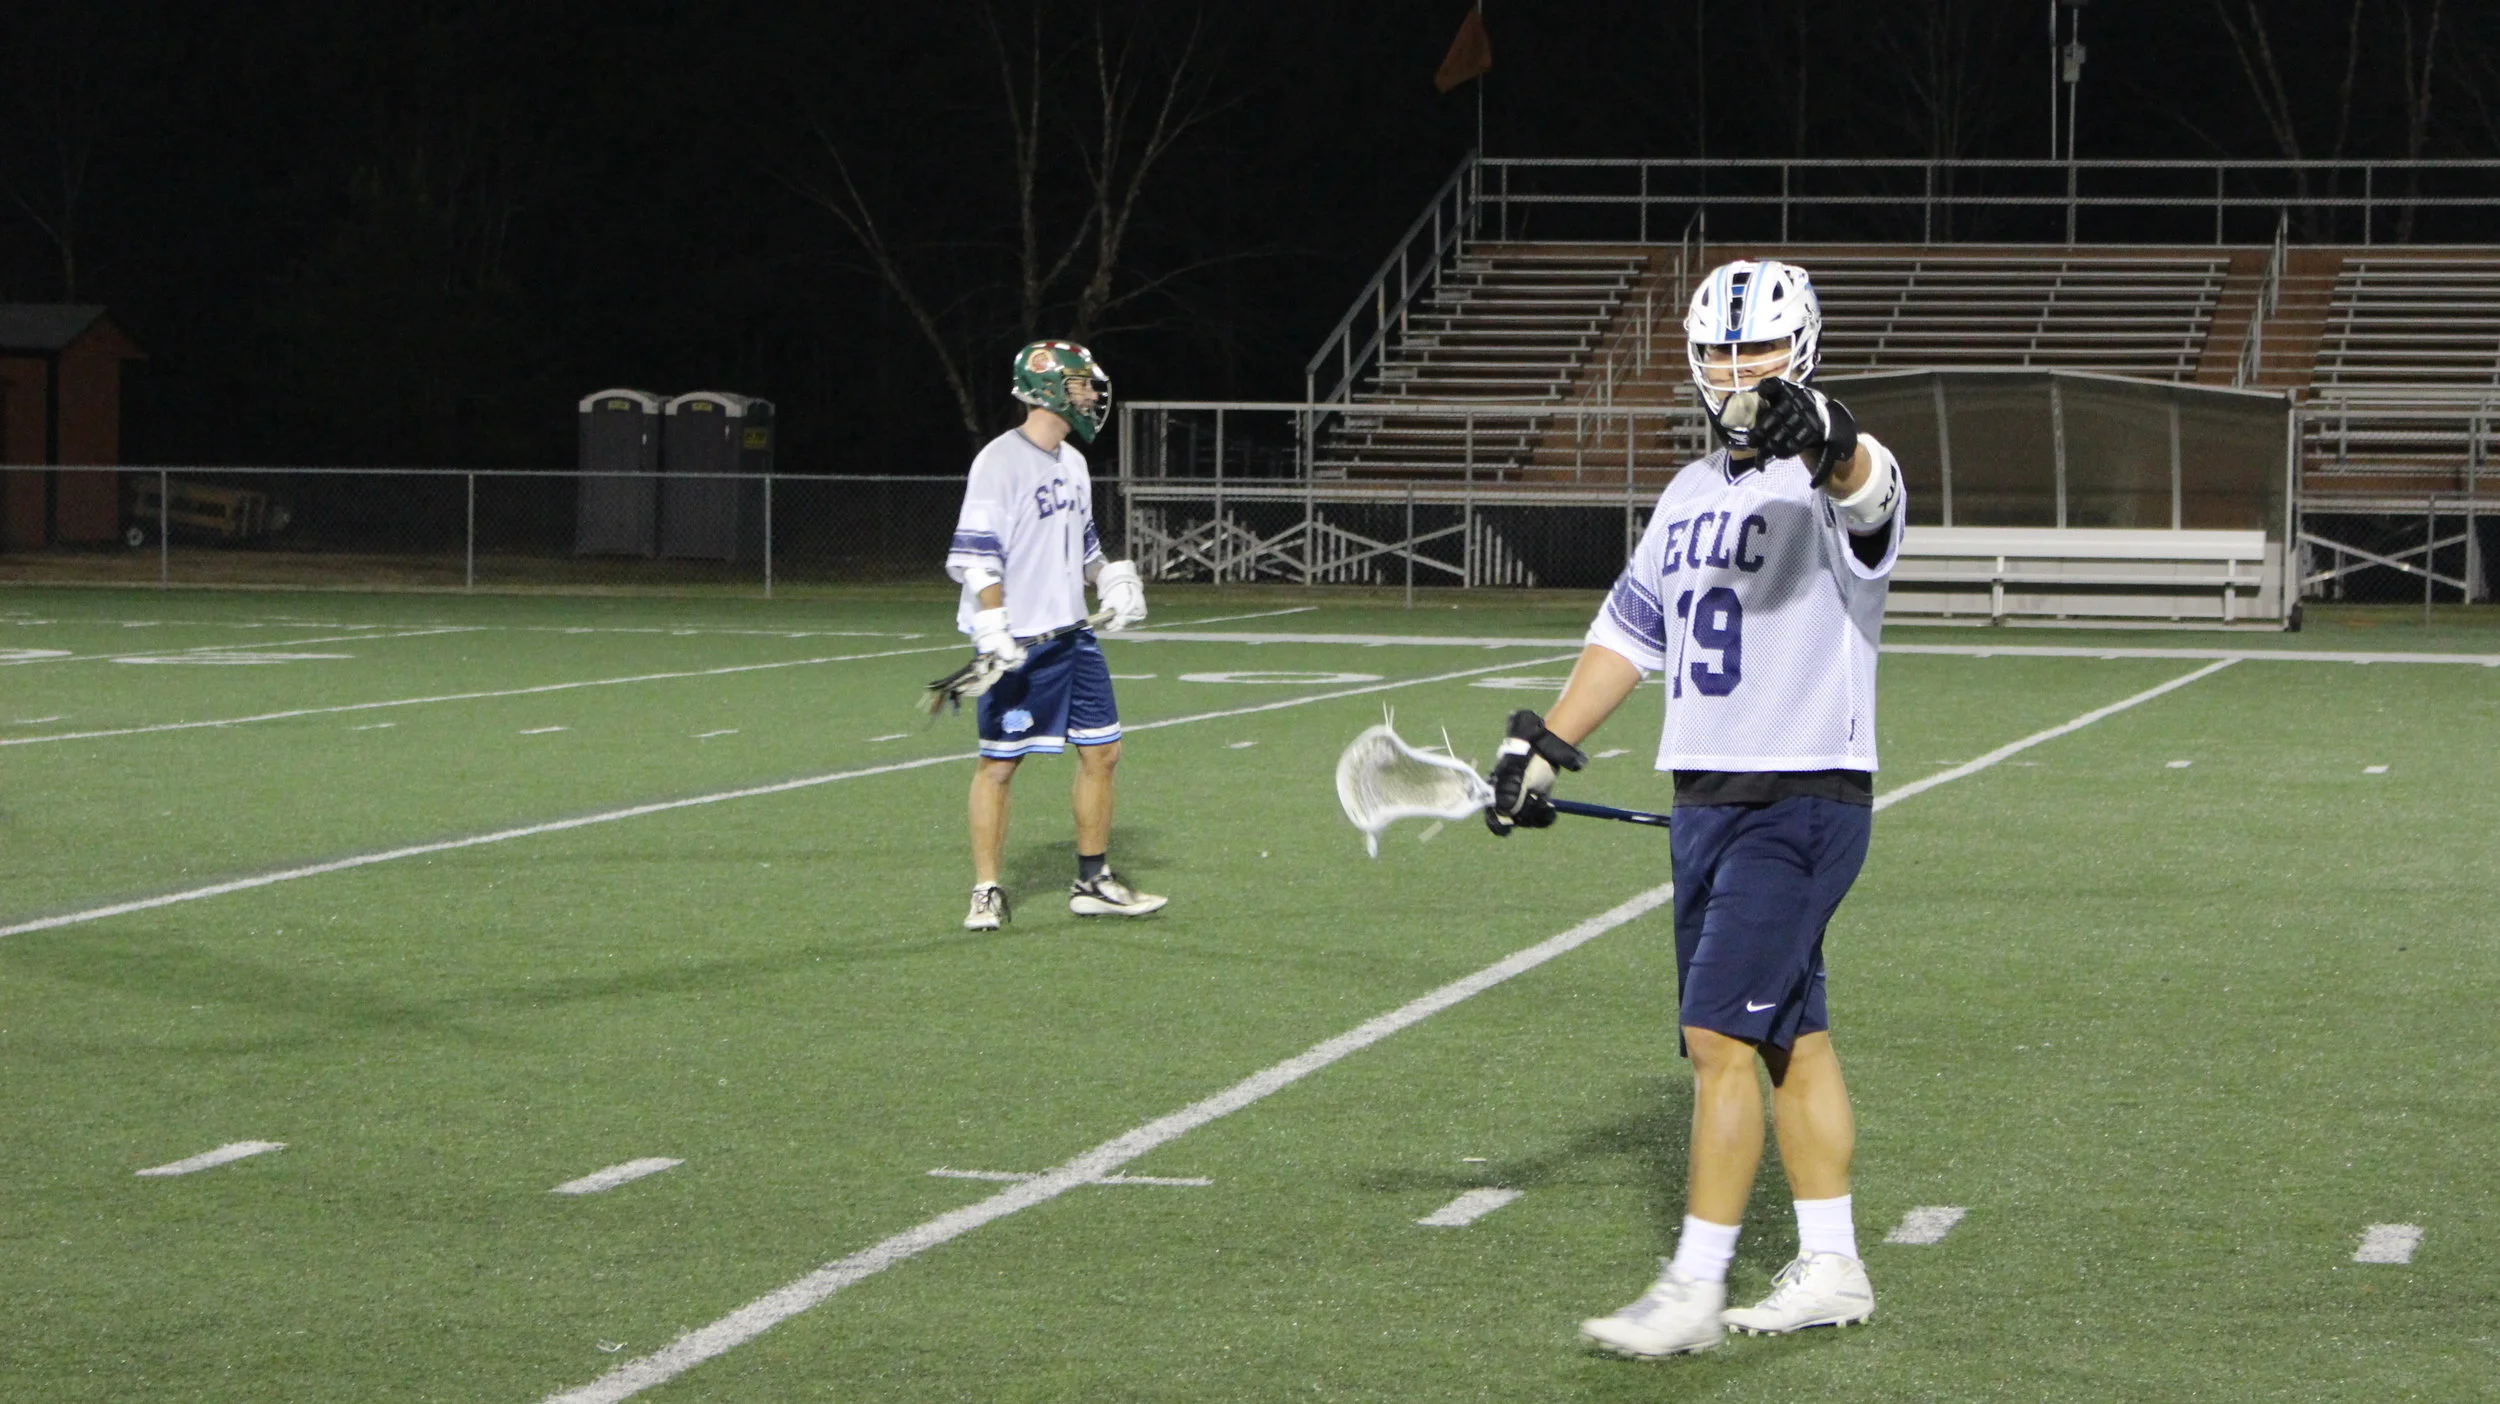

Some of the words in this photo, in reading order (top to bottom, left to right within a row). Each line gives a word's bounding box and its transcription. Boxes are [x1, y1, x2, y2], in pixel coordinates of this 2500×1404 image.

[1034, 478, 1086, 519] EC
[1662, 511, 1766, 577] ECLC
[1673, 586, 1742, 698] 19
